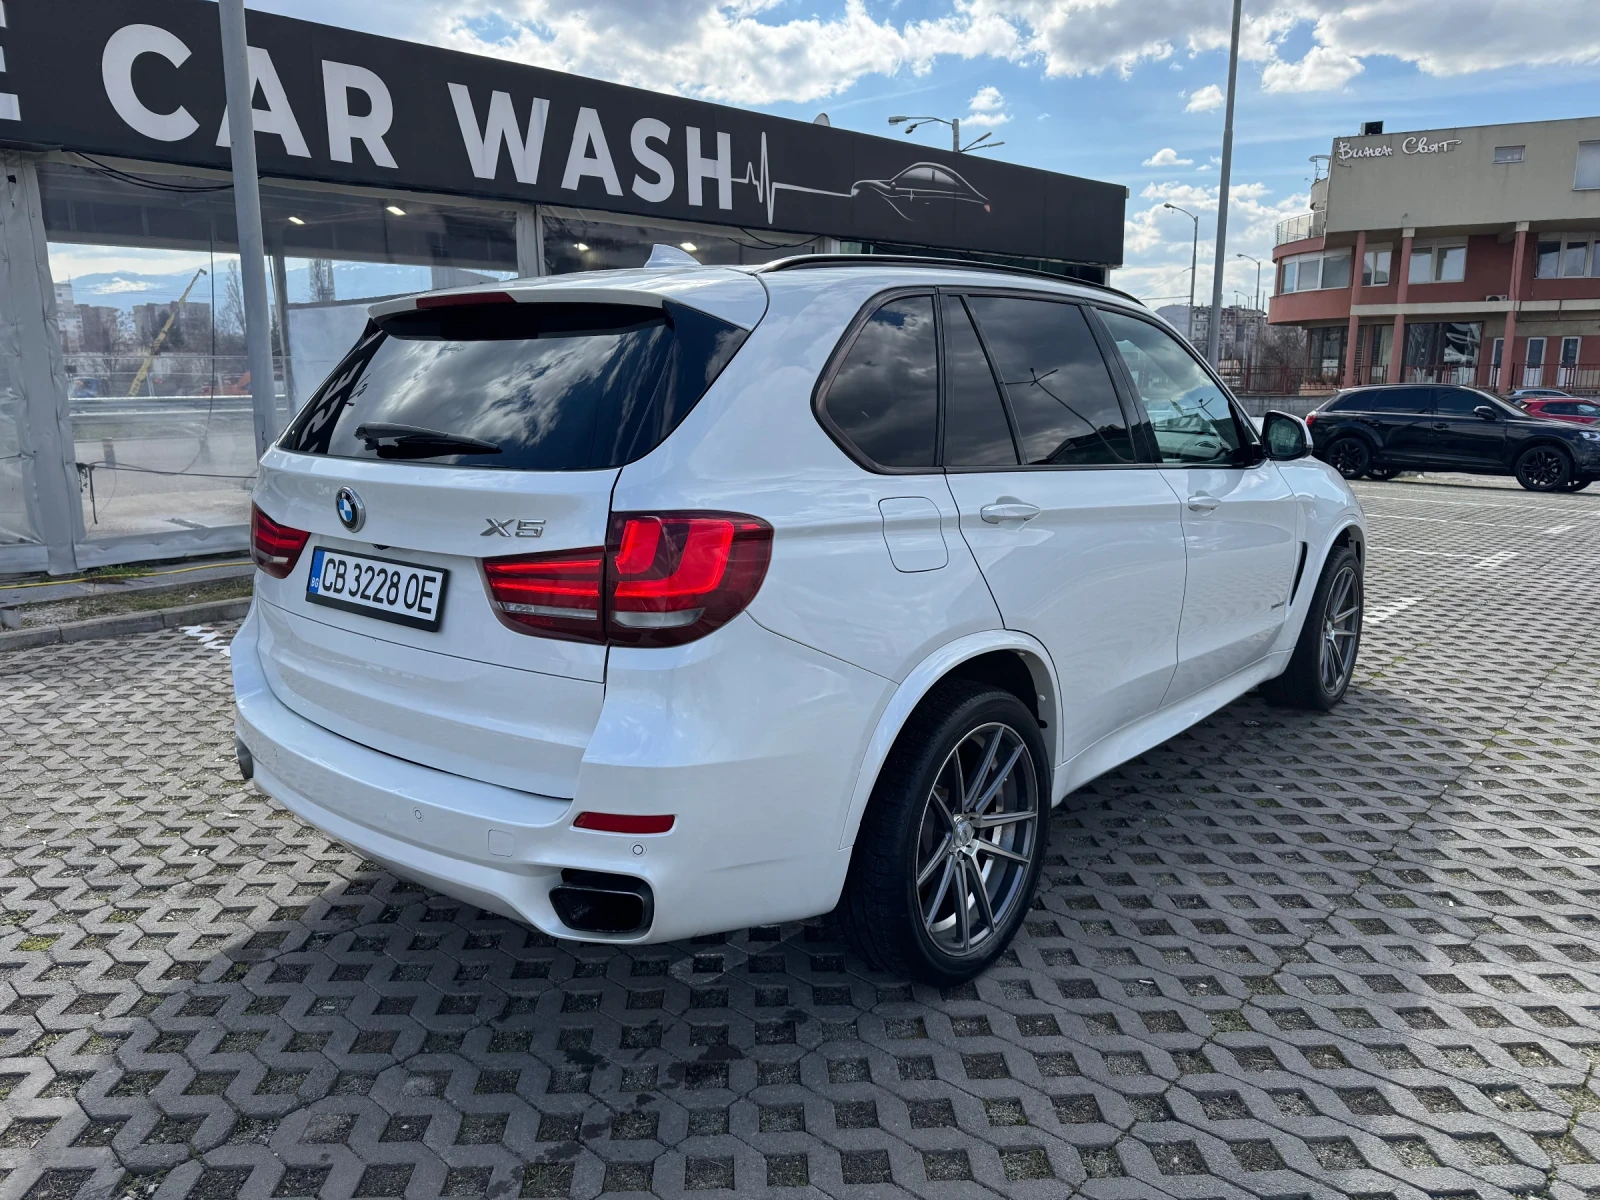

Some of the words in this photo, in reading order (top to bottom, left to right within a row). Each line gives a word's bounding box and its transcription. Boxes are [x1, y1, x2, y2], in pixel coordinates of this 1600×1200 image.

[102, 23, 399, 169] CAR
[447, 82, 733, 211] WASH
[480, 518, 546, 538] X5
[310, 577, 320, 588] BG
[322, 558, 347, 594] CB
[349, 563, 401, 606] 3228
[404, 573, 437, 614] OE
